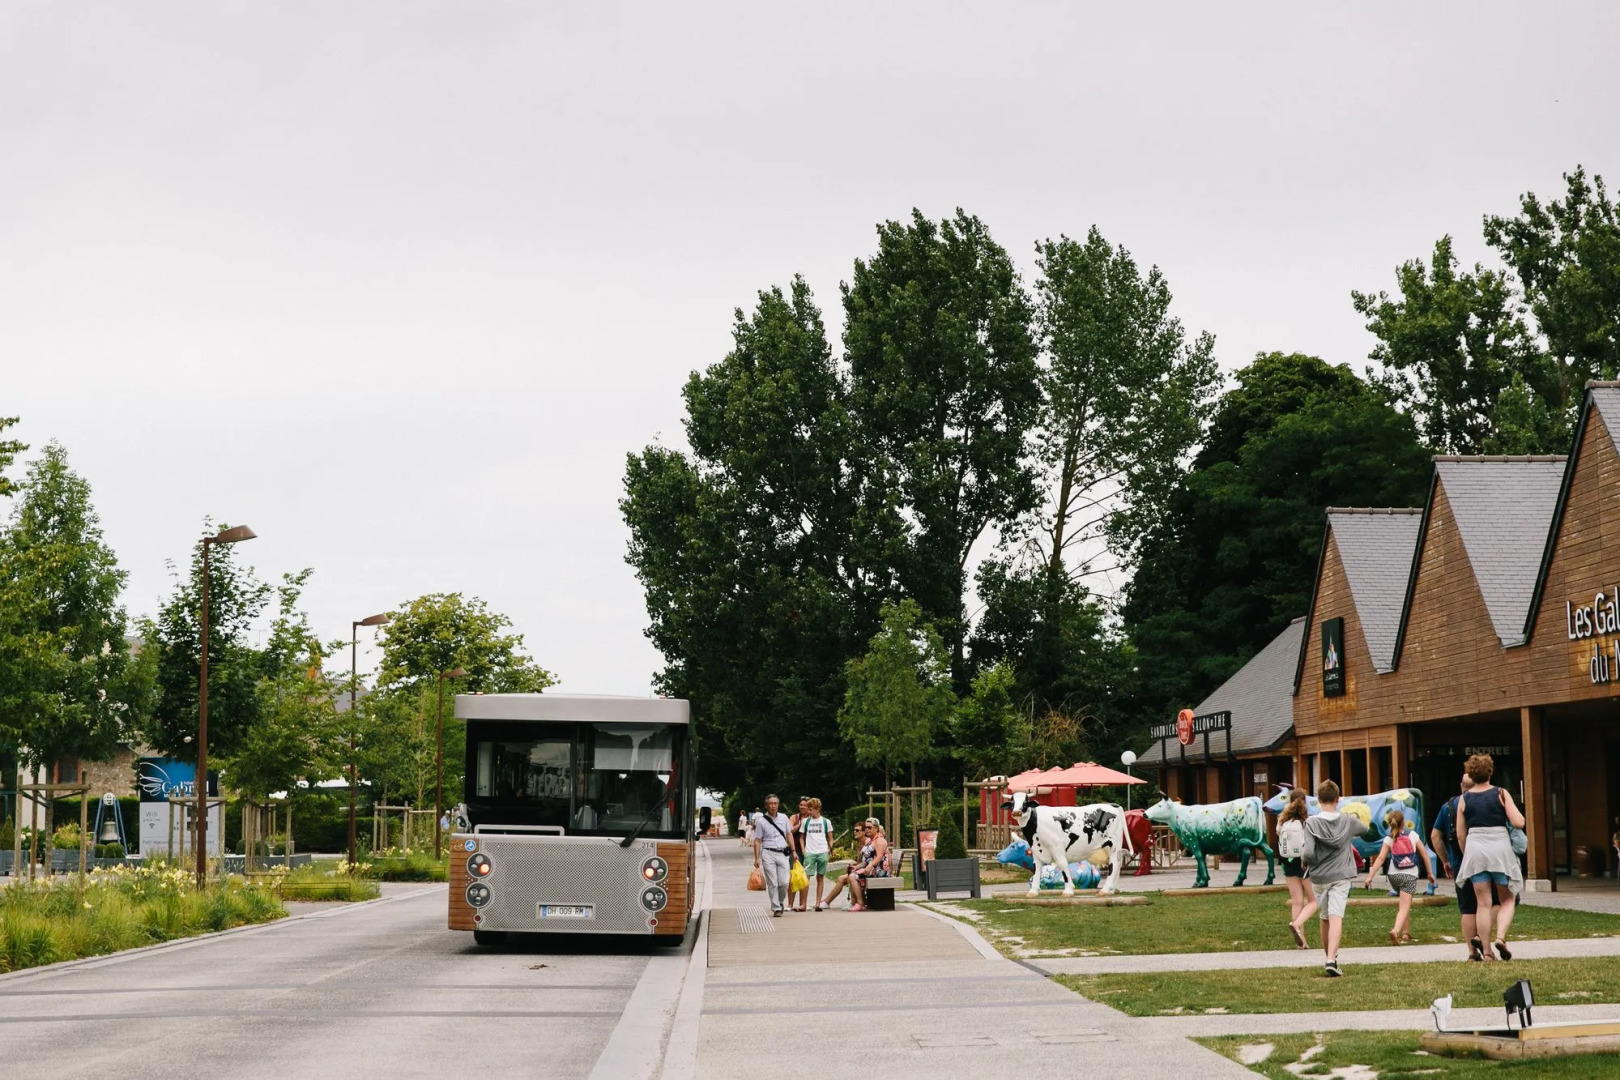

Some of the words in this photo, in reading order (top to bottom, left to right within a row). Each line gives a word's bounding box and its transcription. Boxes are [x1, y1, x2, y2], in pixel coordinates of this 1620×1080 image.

[1566, 600, 1593, 640] Les
[1594, 585, 1620, 635] Gal
[1590, 642, 1609, 683] du
[161, 780, 210, 794] Gabrl
[641, 841, 654, 849] 214
